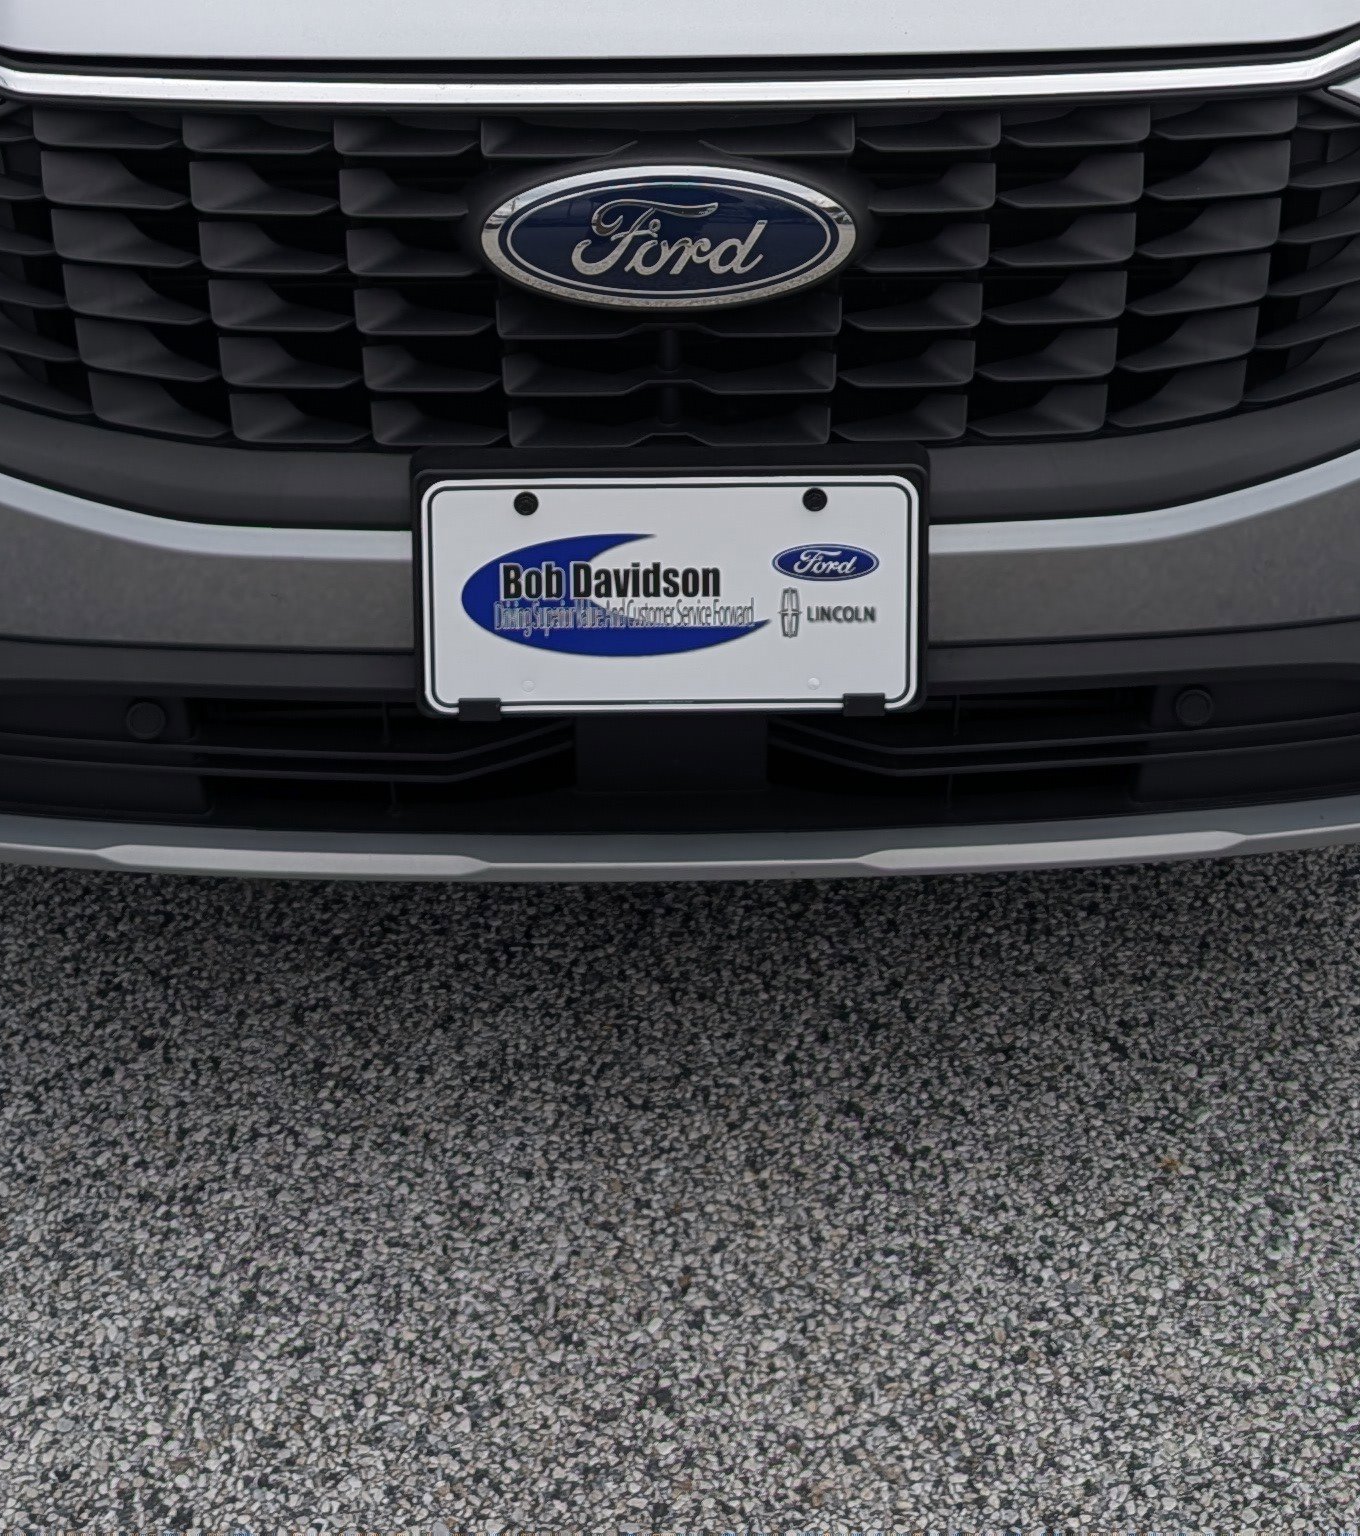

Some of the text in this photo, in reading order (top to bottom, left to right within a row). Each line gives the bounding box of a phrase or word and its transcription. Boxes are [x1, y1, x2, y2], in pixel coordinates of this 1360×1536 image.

[571, 198, 768, 276] Ford
[793, 549, 857, 574] Ford
[501, 561, 721, 600] Bob Davidson
[626, 598, 675, 627] Customer
[675, 598, 711, 627] Service
[712, 597, 755, 627] Forward
[807, 605, 876, 623] LINCOLN
